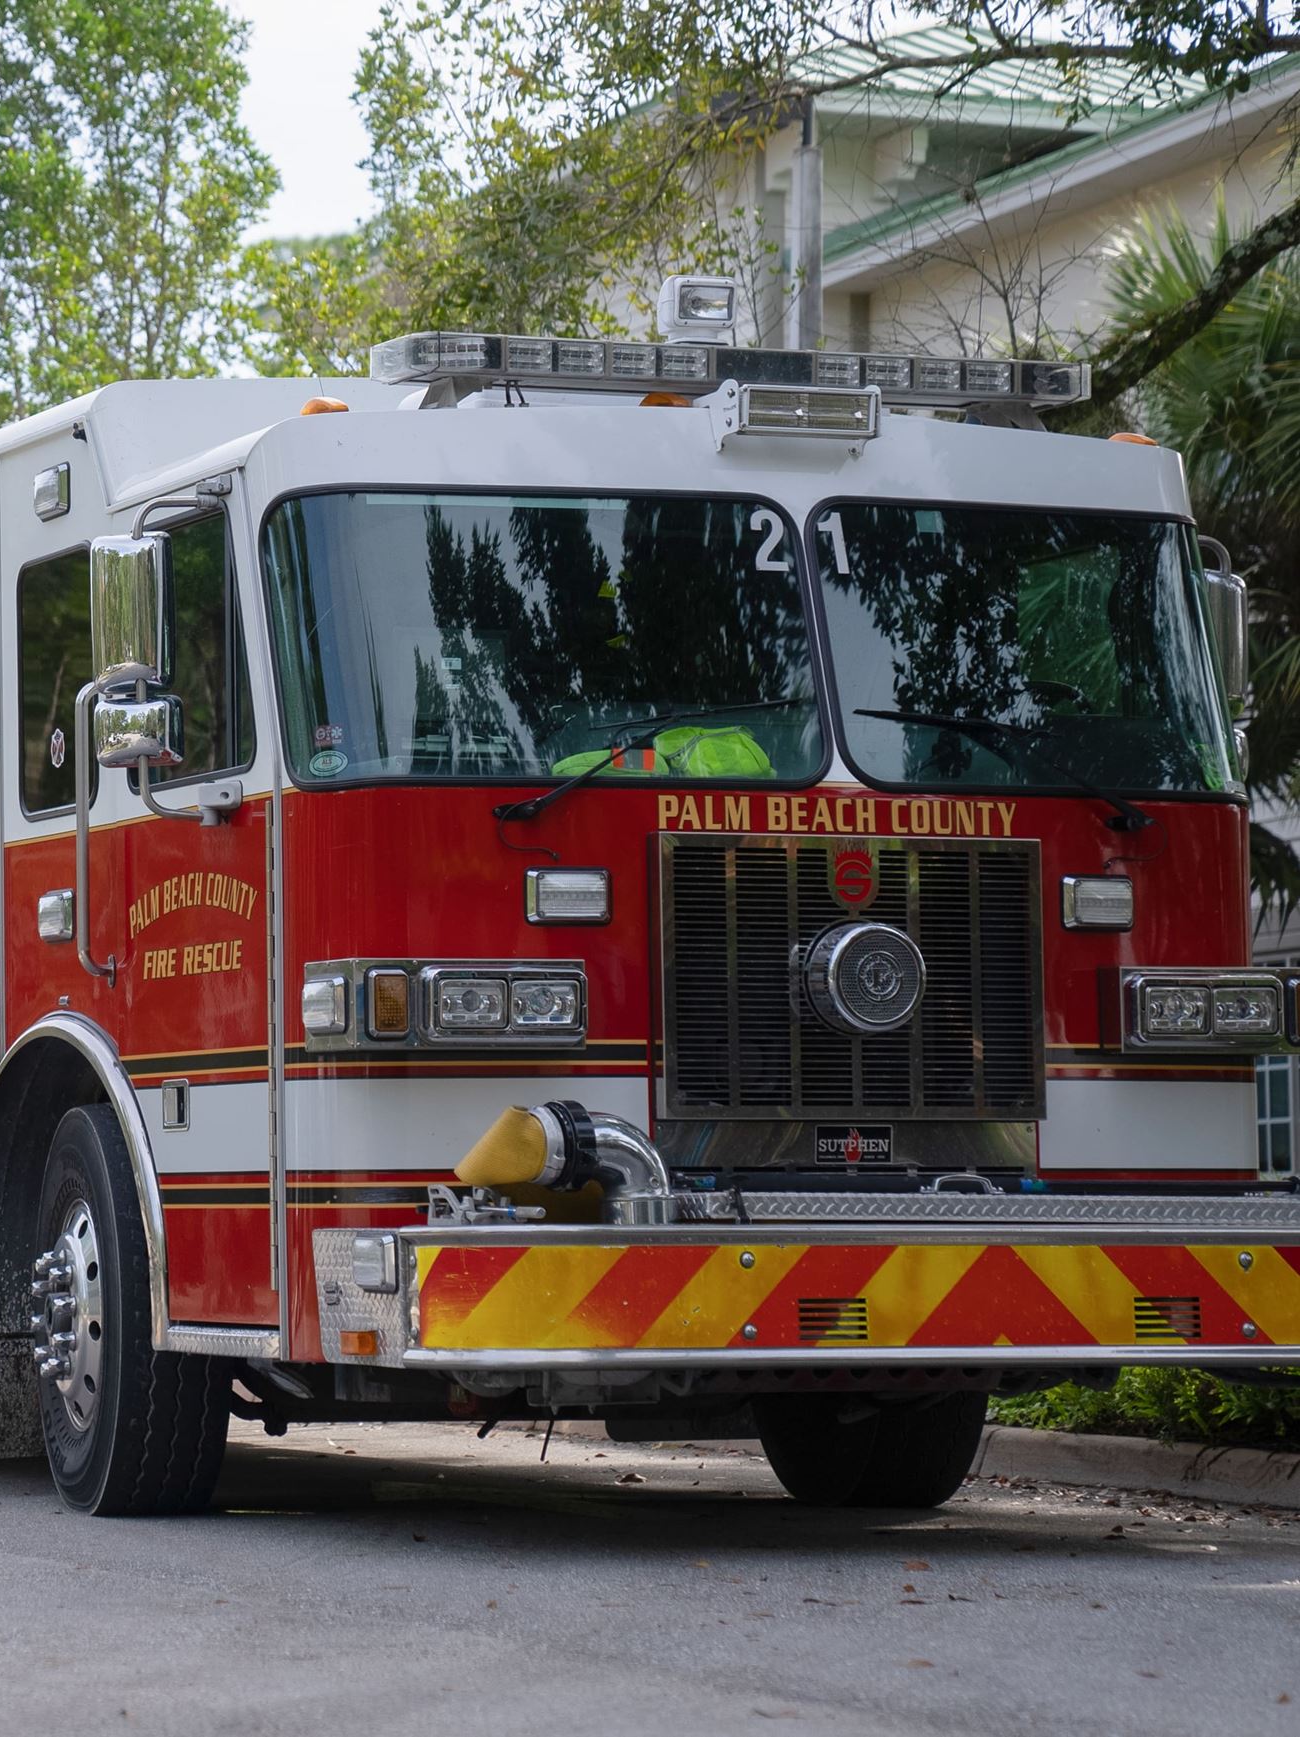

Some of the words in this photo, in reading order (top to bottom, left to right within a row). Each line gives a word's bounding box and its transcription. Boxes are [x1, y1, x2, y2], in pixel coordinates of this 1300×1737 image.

[750, 509, 790, 571] 2
[817, 512, 850, 574] 1
[657, 794, 751, 831] PALM
[766, 796, 877, 833] BEACH
[891, 800, 1017, 837] COUNTY
[129, 885, 160, 939] PALM
[163, 872, 204, 915] BEACH
[205, 872, 258, 920] COUNTY
[143, 948, 177, 980] FIRE
[182, 939, 243, 976] RESCUE
[818, 1138, 890, 1153] SUTPHEN
